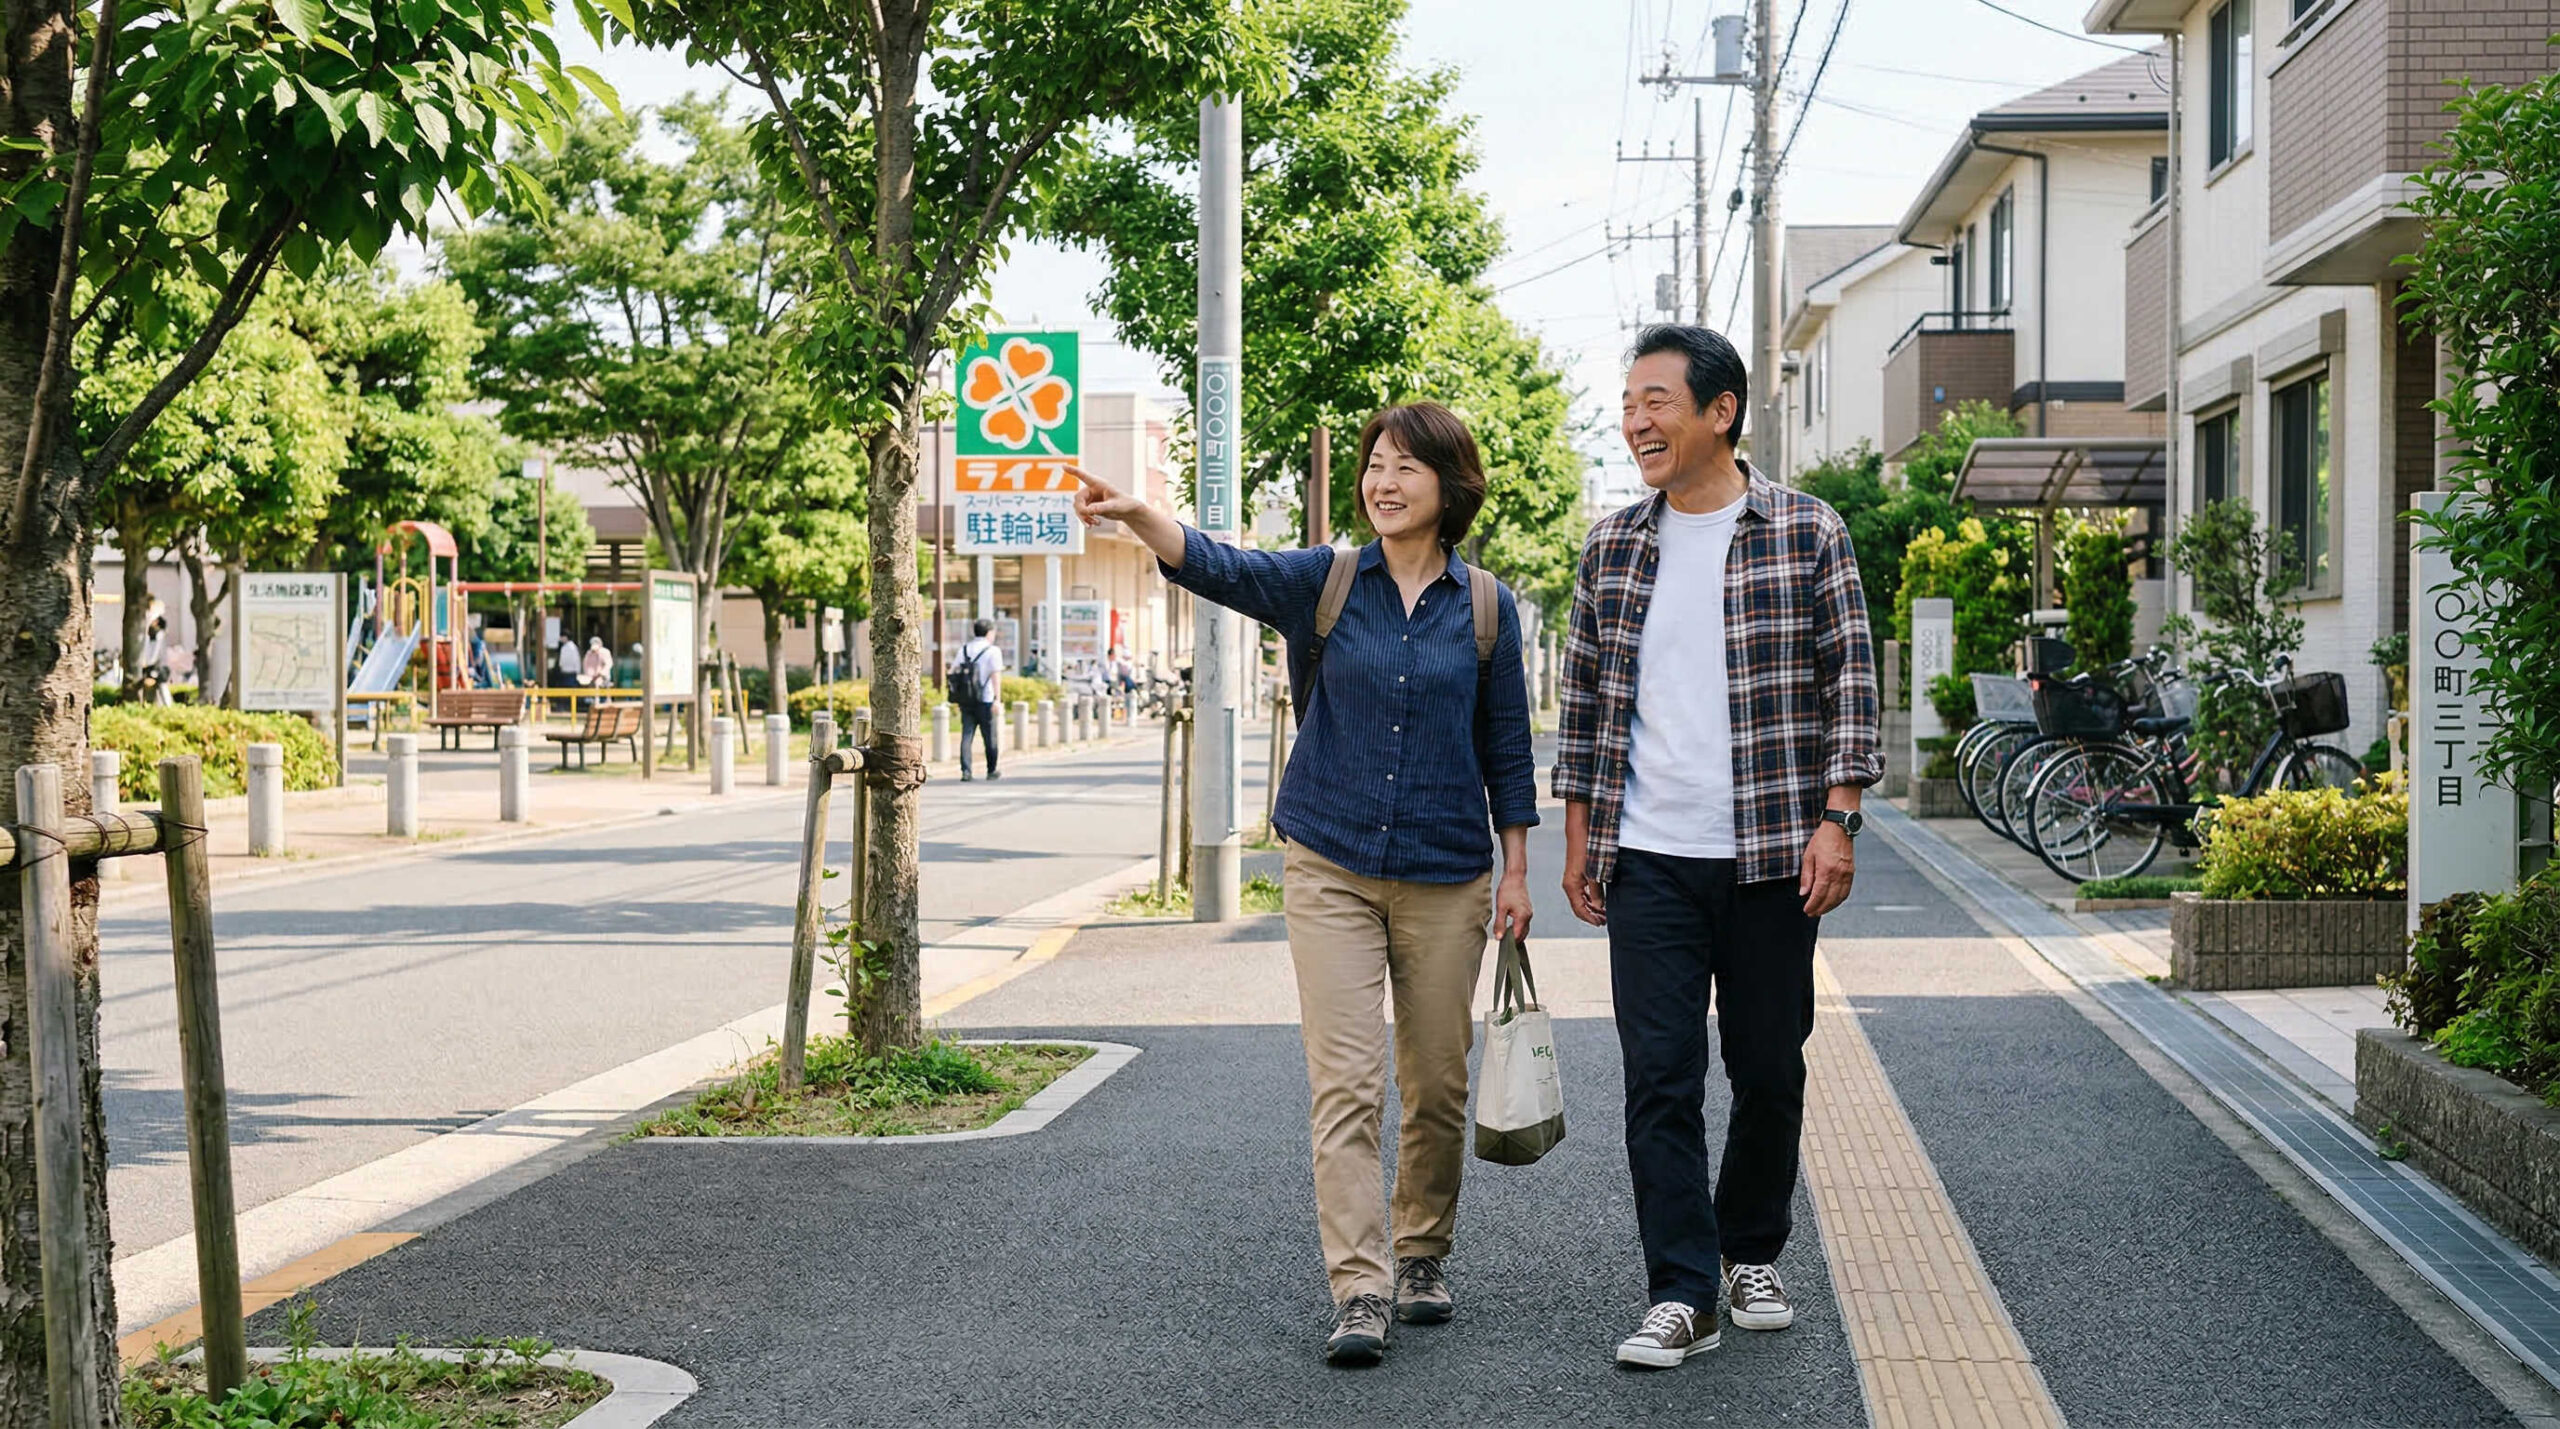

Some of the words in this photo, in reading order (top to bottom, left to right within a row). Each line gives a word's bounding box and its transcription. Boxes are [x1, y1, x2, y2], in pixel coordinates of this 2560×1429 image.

[965, 494, 1072, 507] スーパーマーケット
[966, 511, 1070, 545] 駐輪場
